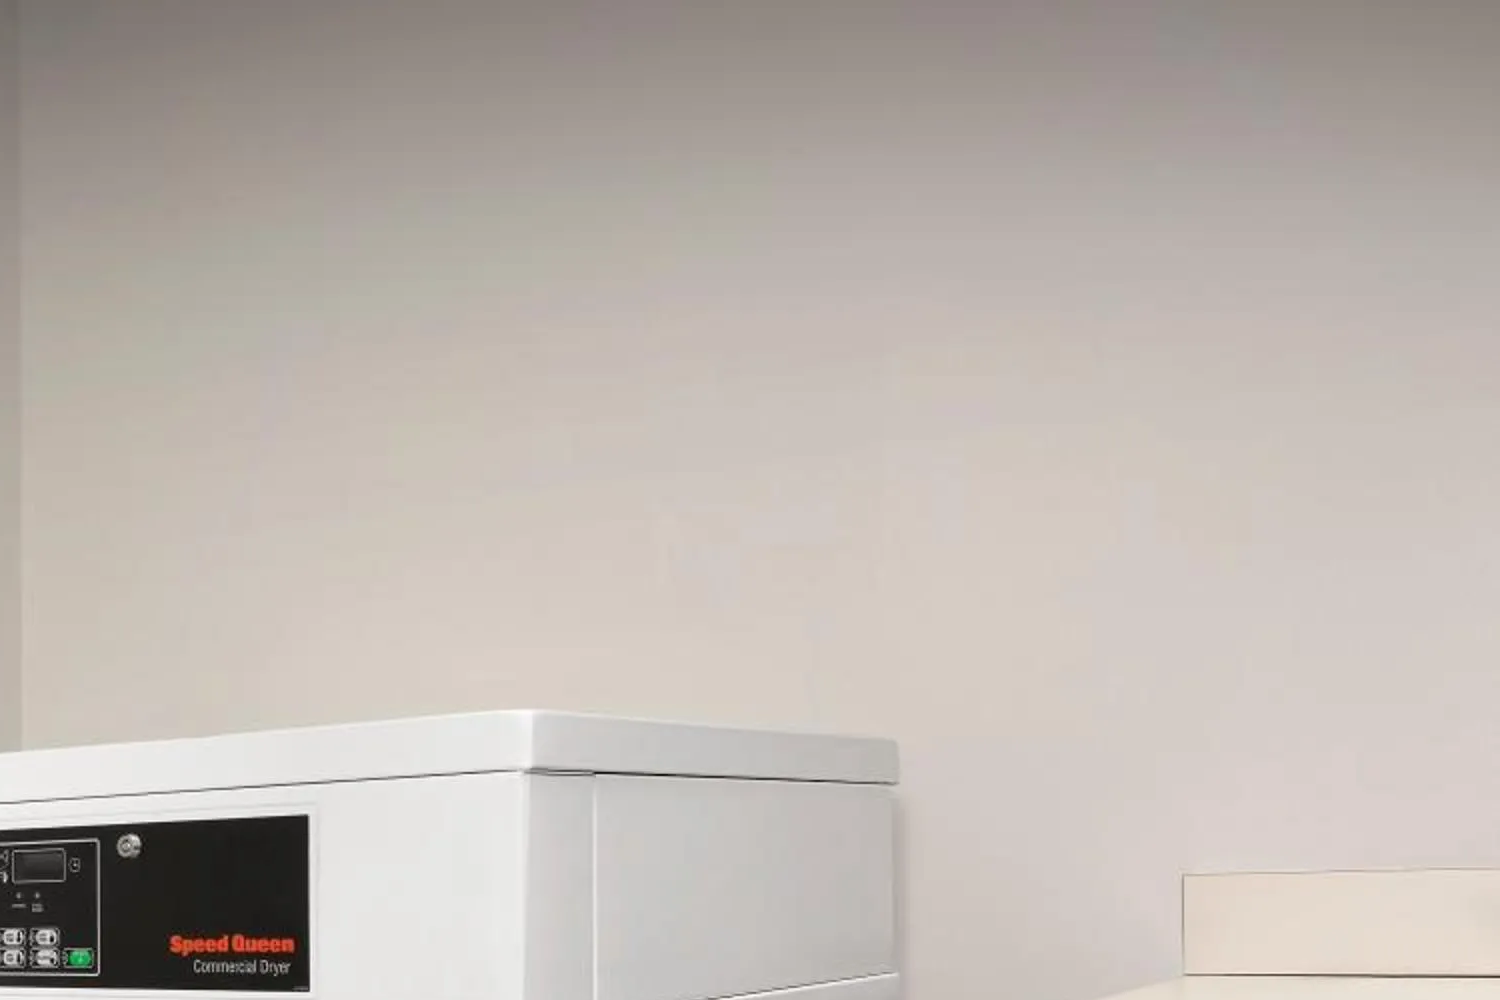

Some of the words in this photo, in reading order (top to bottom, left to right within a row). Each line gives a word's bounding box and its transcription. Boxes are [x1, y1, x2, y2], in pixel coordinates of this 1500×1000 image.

[169, 934, 229, 957] Speed
[231, 933, 295, 954] Queen
[193, 959, 257, 974] Commercial
[260, 959, 292, 977] Dryer
